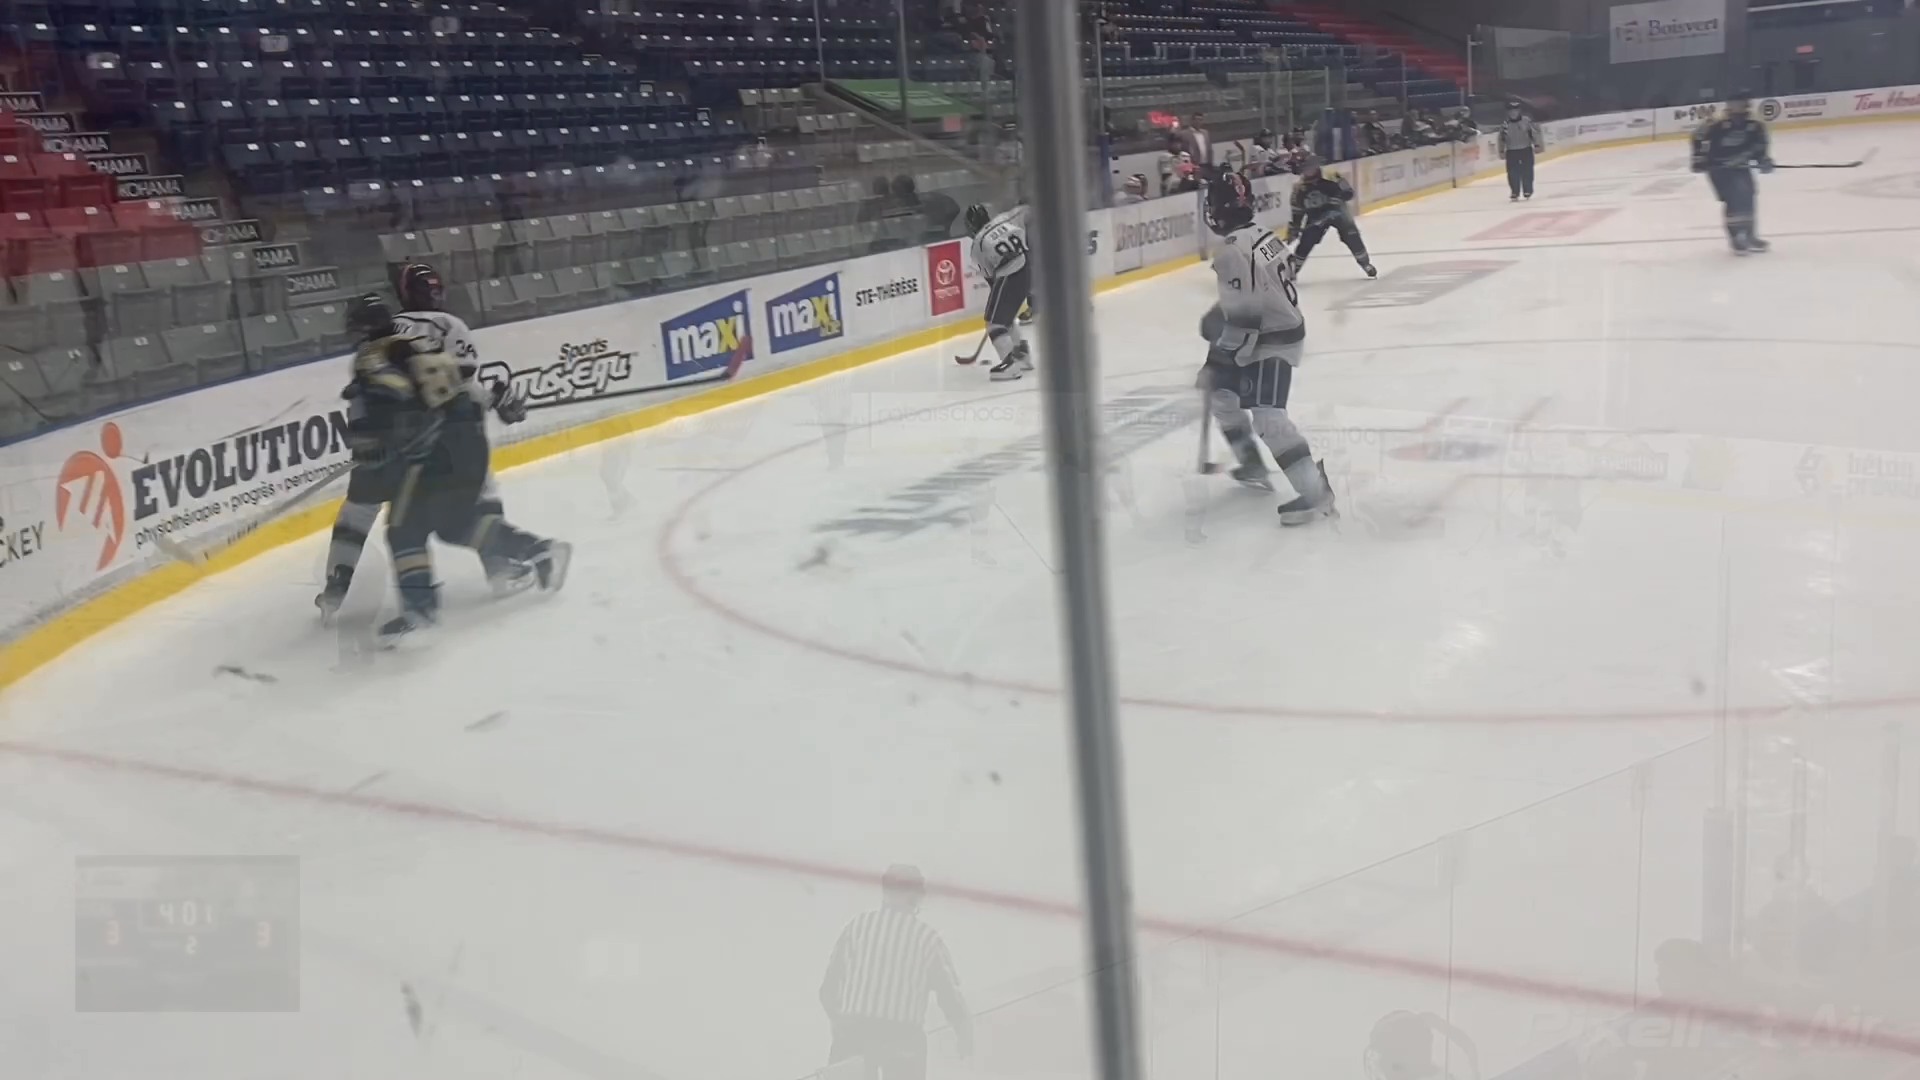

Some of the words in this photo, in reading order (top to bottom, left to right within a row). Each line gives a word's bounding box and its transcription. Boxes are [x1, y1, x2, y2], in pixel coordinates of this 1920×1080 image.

[771, 279, 838, 338] maxi
[558, 338, 609, 361] Sports
[668, 299, 746, 365] maxi
[230, 480, 276, 511] progrès
